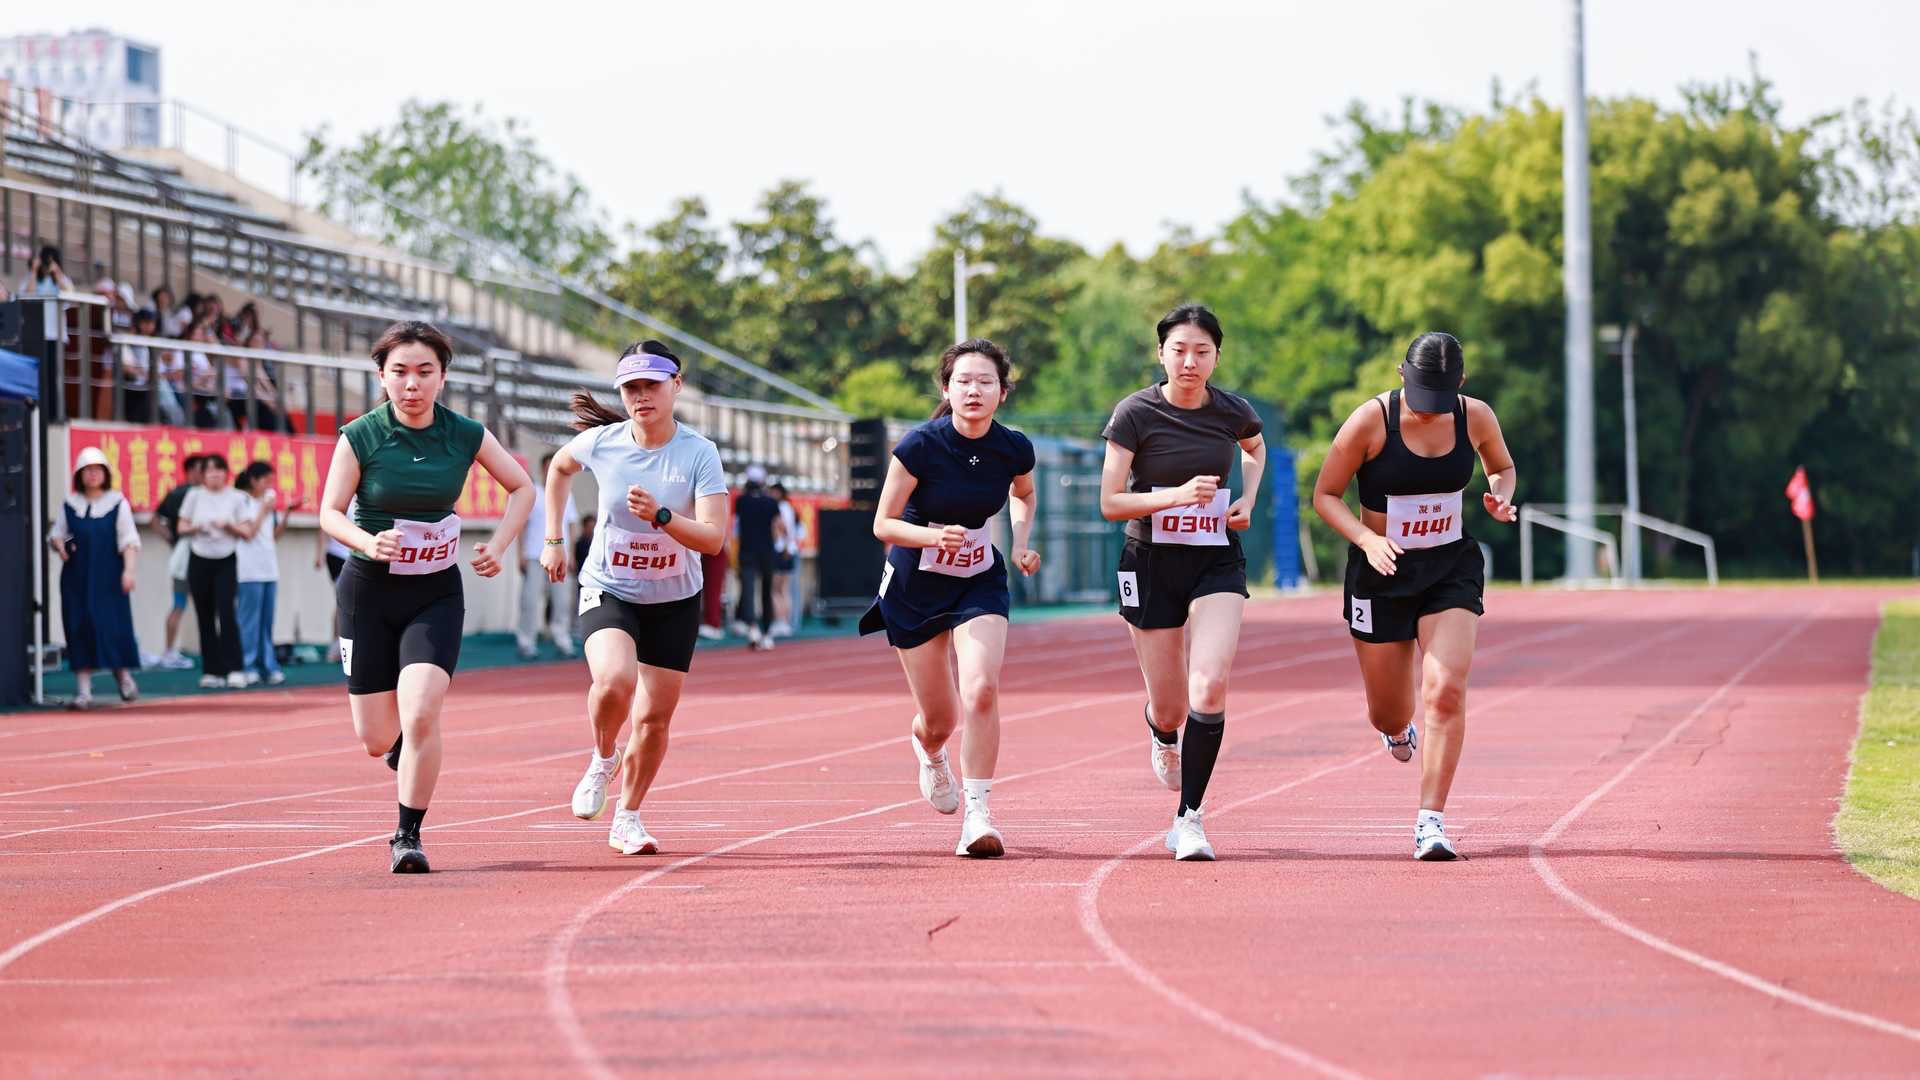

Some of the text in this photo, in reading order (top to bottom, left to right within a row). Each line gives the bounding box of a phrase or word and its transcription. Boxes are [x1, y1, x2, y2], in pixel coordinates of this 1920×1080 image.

[1162, 515, 1219, 533] 0341
[1401, 512, 1453, 537] 1441
[399, 536, 458, 563] 0437
[935, 544, 985, 567] 1139
[611, 551, 677, 570] 0241
[1123, 580, 1132, 597] 6
[1355, 607, 1365, 623] 2
